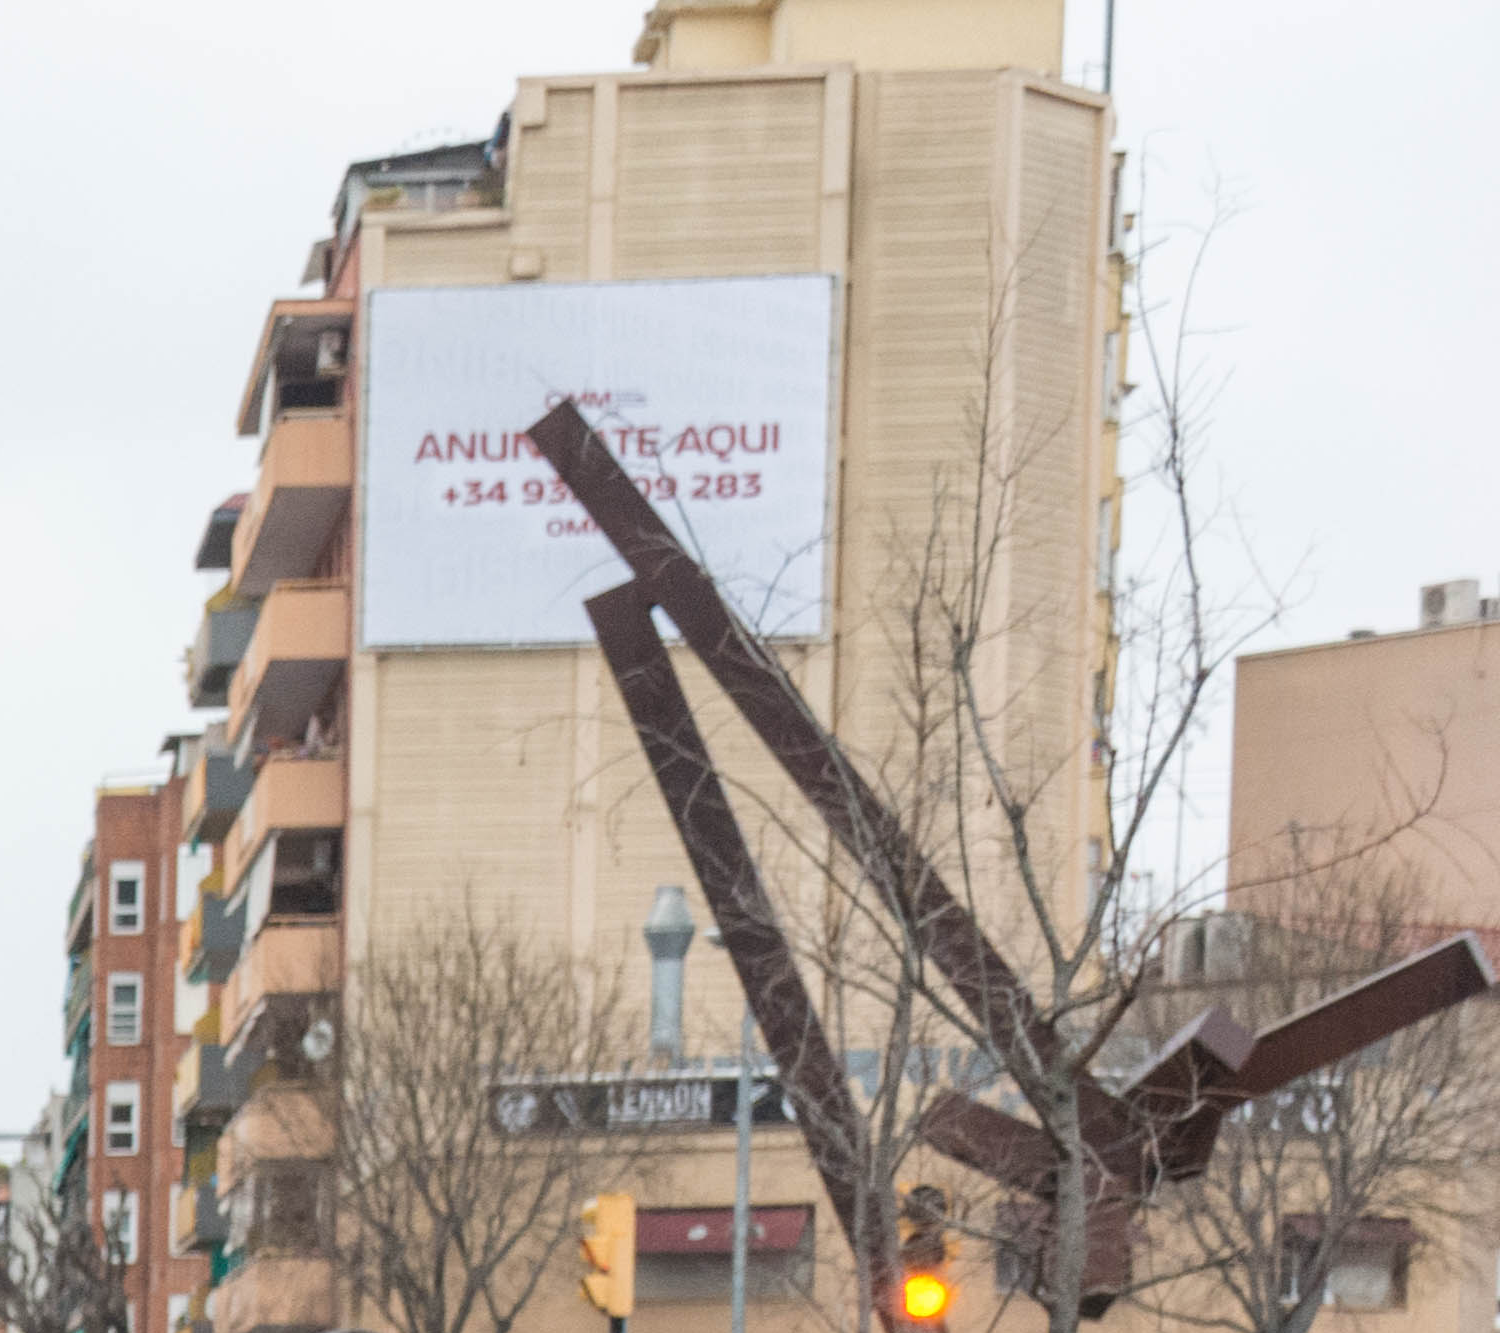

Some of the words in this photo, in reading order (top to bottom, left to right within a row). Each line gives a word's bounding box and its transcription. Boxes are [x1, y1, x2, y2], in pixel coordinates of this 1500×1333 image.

[676, 422, 781, 462] AQUI
[443, 479, 508, 506] +34
[690, 472, 763, 500] 283
